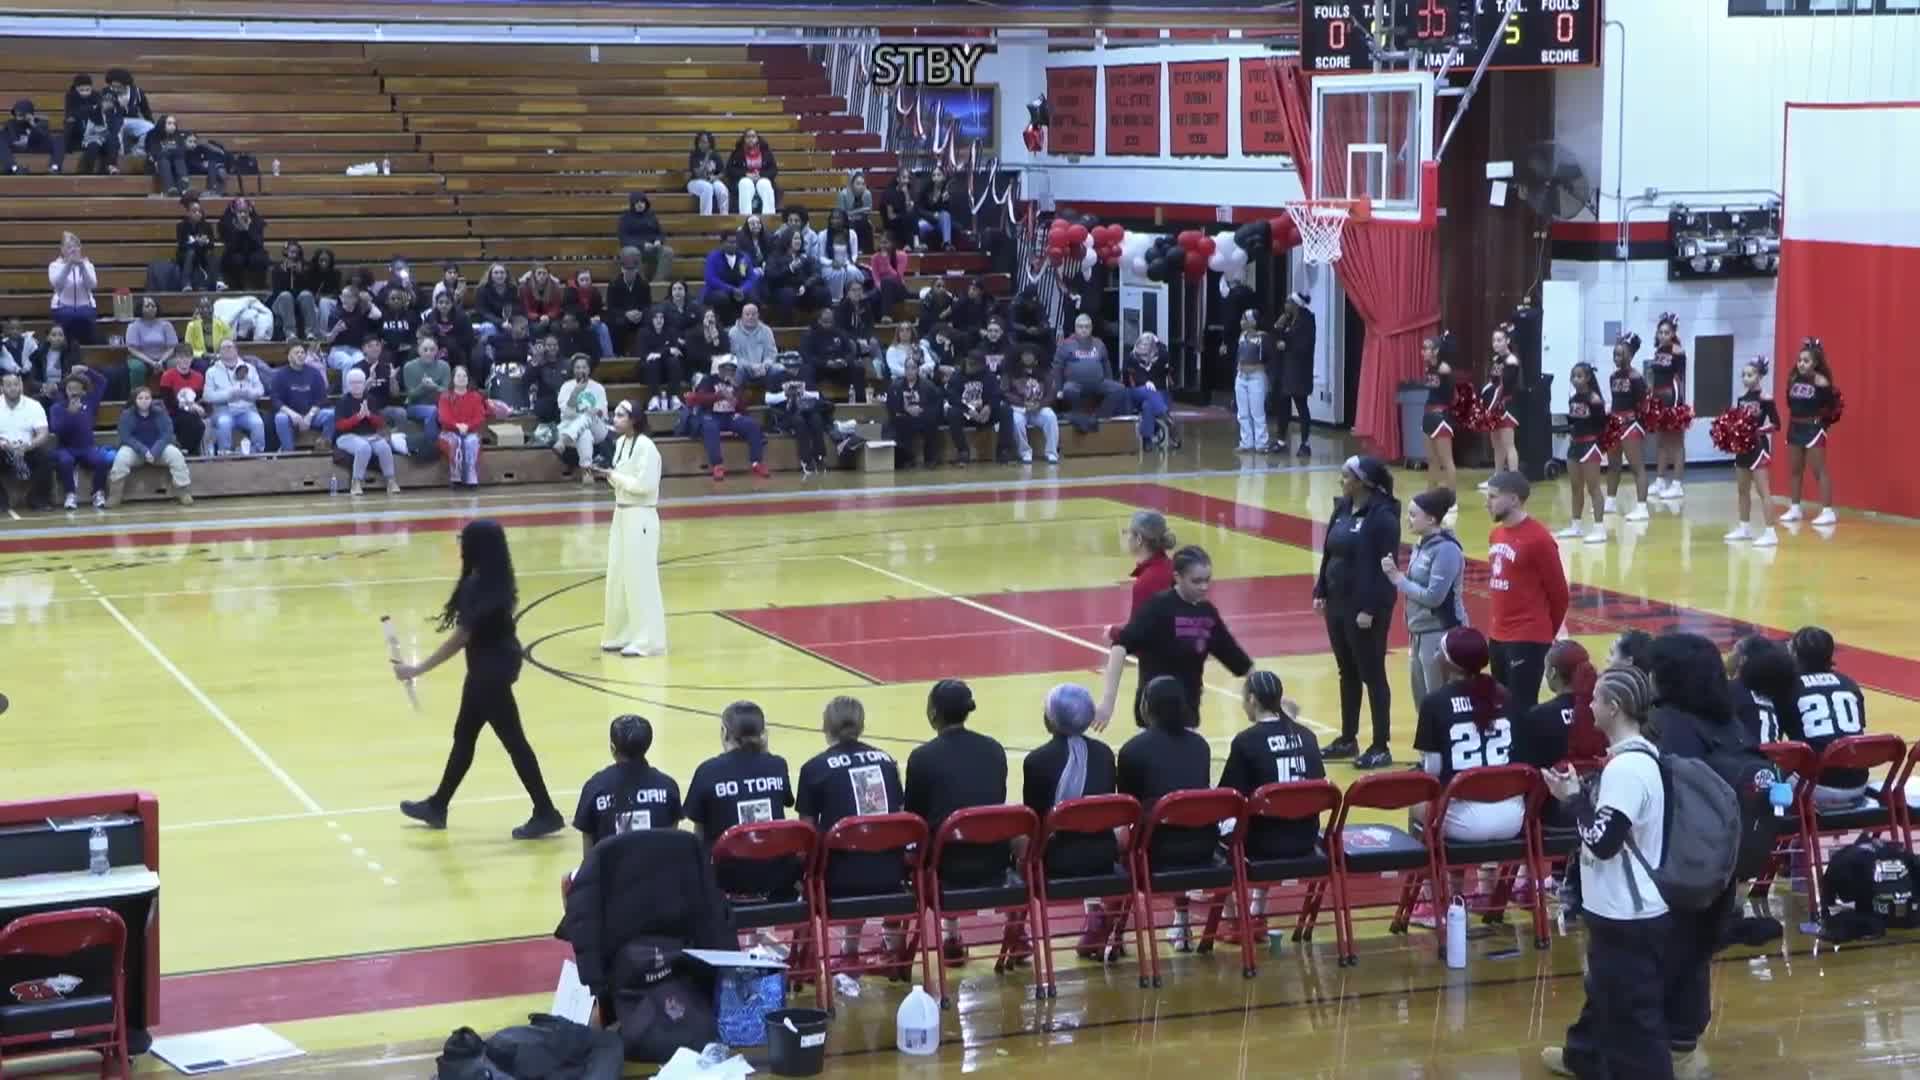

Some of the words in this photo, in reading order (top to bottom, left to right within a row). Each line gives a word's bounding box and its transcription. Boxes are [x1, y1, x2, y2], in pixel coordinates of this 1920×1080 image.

[1314, 4, 1350, 19] FOULS
[1541, 0, 1580, 11] FOULS
[1330, 20, 1345, 49] 0
[1504, 15, 1520, 44] 5
[1557, 13, 1573, 42] 0
[1315, 56, 1351, 69] SCORE
[1541, 49, 1580, 63] SCORE
[1797, 691, 1861, 738] 20
[1449, 717, 1512, 770] 22
[827, 753, 851, 769] GO
[636, 788, 667, 804] ORI!
[715, 781, 739, 798] GO
[743, 777, 784, 793] TORI!
